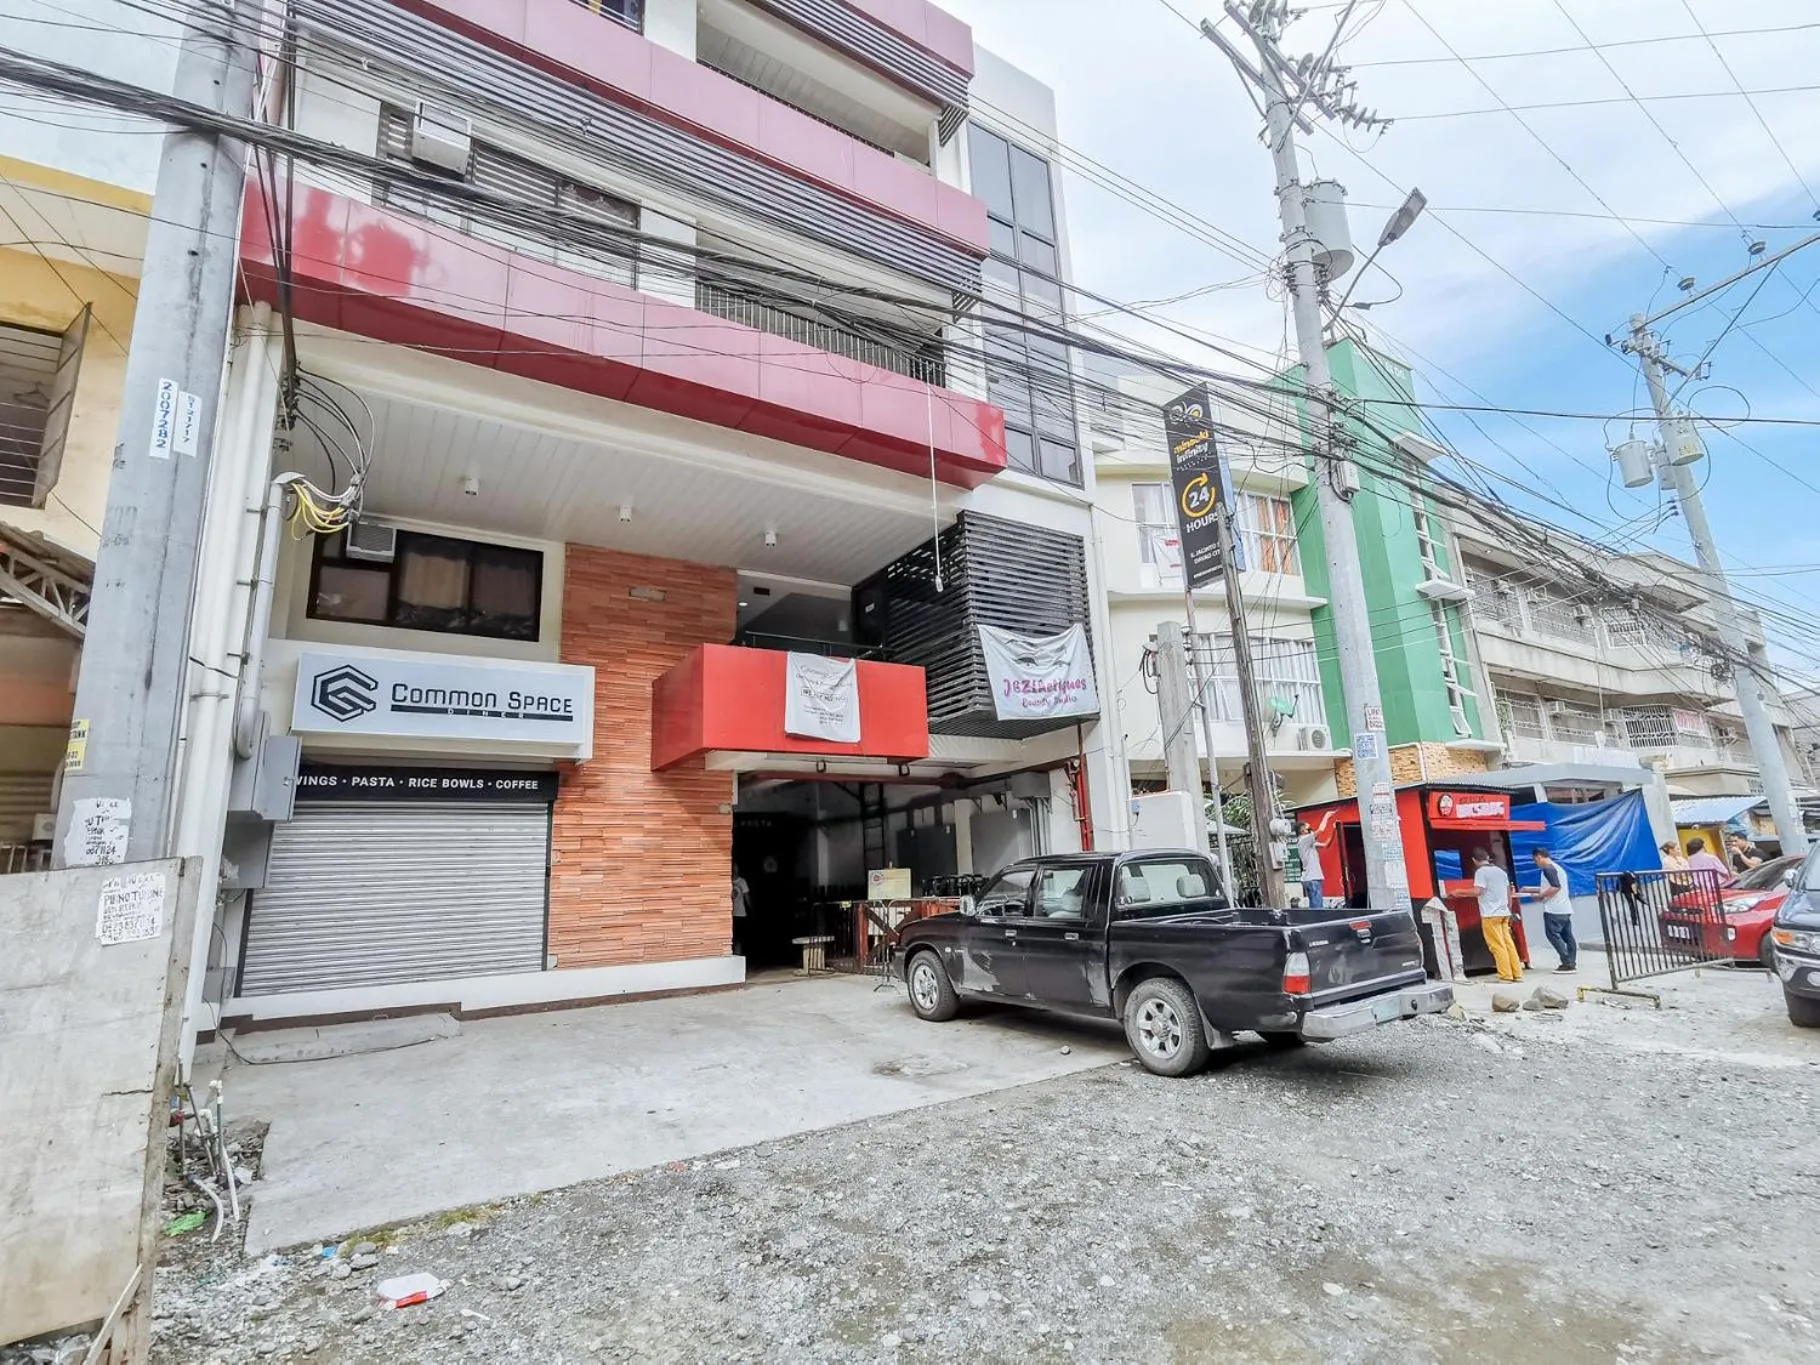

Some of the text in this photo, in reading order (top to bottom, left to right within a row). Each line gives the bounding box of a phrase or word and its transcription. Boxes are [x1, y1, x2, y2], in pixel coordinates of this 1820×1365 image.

[1188, 486, 1210, 509] 24
[391, 683, 497, 708] Common
[351, 776, 395, 787] PASTA
[408, 778, 438, 788] RICE
[442, 778, 484, 789] BOWLS
[495, 779, 539, 790] COFFEE
